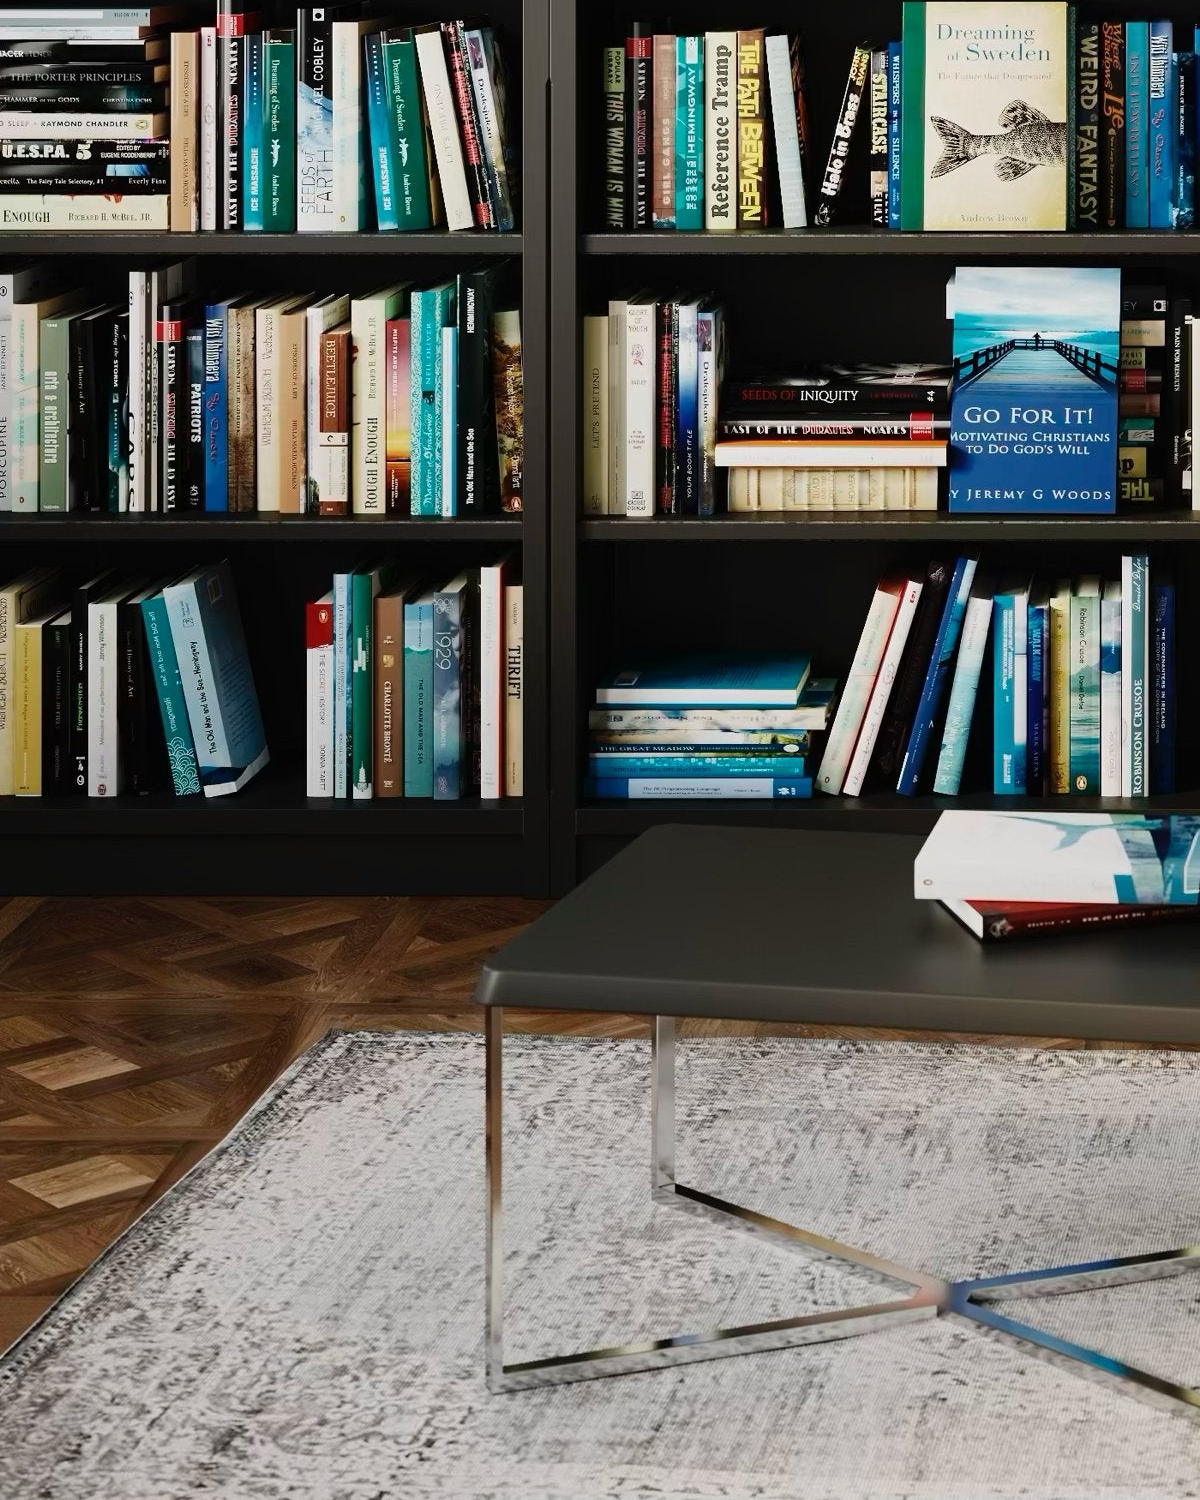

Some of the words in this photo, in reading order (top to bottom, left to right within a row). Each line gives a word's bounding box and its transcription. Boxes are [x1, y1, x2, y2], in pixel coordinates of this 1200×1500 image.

[936, 24, 1035, 43] Dreaming
[966, 43, 1051, 61] Sweden
[80, 73, 141, 81] PRINCIPLES
[229, 41, 238, 85] NOAKES
[313, 37, 324, 81] COBLEY
[737, 39, 759, 74] THE
[1080, 36, 1098, 110] WEIRD
[712, 44, 732, 111] Tramp
[607, 93, 623, 122] THIS
[688, 67, 696, 153] HEMINGWAY
[737, 78, 759, 119] PATH
[871, 73, 887, 155] STAIRCASE
[228, 95, 238, 146] PIRATES
[2, 145, 70, 159] U.E.S.P.A.
[229, 150, 238, 172] THE
[607, 127, 623, 174] WOMAN
[712, 116, 729, 218] Reference
[229, 179, 238, 192] OF
[302, 167, 316, 214] SEEDS
[608, 179, 623, 193] IS
[1079, 125, 1098, 224] FANTASY
[3, 210, 50, 223] ENOUGH
[229, 201, 238, 225] LAST
[608, 197, 623, 228] MINE
[325, 340, 336, 419] BEETLEJUICE
[742, 390, 777, 400] SEEDS
[780, 390, 796, 400] OF
[800, 391, 859, 403] INIQUITY
[190, 383, 202, 443] PATRIOTS
[964, 407, 1000, 424] GO
[1011, 407, 1056, 424] FOR
[1064, 407, 1093, 424] IT!
[366, 417, 378, 463] ENOUGH
[966, 445, 983, 454] TO
[989, 445, 1008, 454] DO
[1014, 445, 1054, 454] GOD'S
[1058, 445, 1090, 455] WILL
[1032, 431, 1110, 442] CHRISTIANS
[365, 468, 378, 509] ROUGH
[967, 489, 1025, 500] JEREMY
[1033, 489, 1043, 499] G
[1052, 490, 1111, 500] WOODS
[436, 632, 451, 670] 1929
[1032, 628, 1040, 682] WALKAWAY
[508, 645, 521, 700] THRIFT
[384, 681, 392, 728] CHARLOTTE
[1133, 679, 1143, 726] CRUSOE
[1133, 731, 1143, 794] ROBINSON
